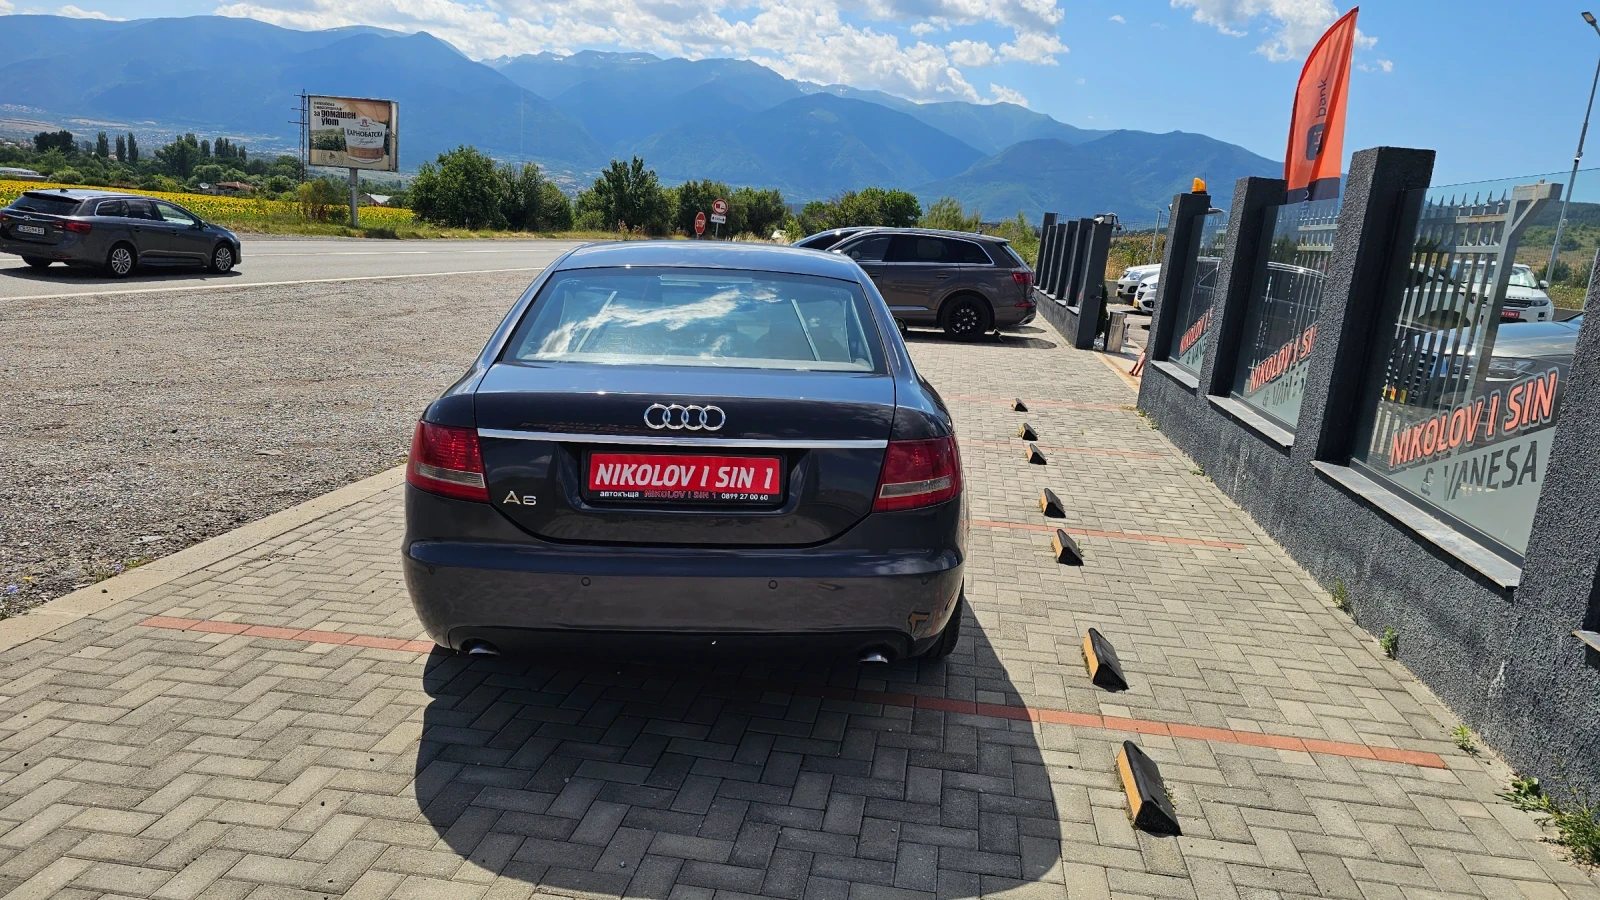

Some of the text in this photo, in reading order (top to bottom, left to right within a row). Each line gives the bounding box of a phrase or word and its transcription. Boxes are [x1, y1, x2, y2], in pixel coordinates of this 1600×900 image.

[1316, 78, 1328, 119] bank
[321, 110, 356, 119] домашен
[321, 117, 339, 126] уют
[1249, 341, 1293, 393] NIKOLOV
[1293, 336, 1301, 364] I
[1389, 368, 1558, 468] NIKOLOV I SIN
[595, 463, 774, 489] NIKOLOV I SIN 1
[1420, 440, 1538, 501] & VANESA
[502, 490, 538, 507] A6
[600, 490, 640, 499] автокъща
[644, 489, 686, 499] NIKOLOV
[693, 491, 709, 499] SIN
[721, 492, 738, 500] 0899
[750, 493, 758, 501] 00
